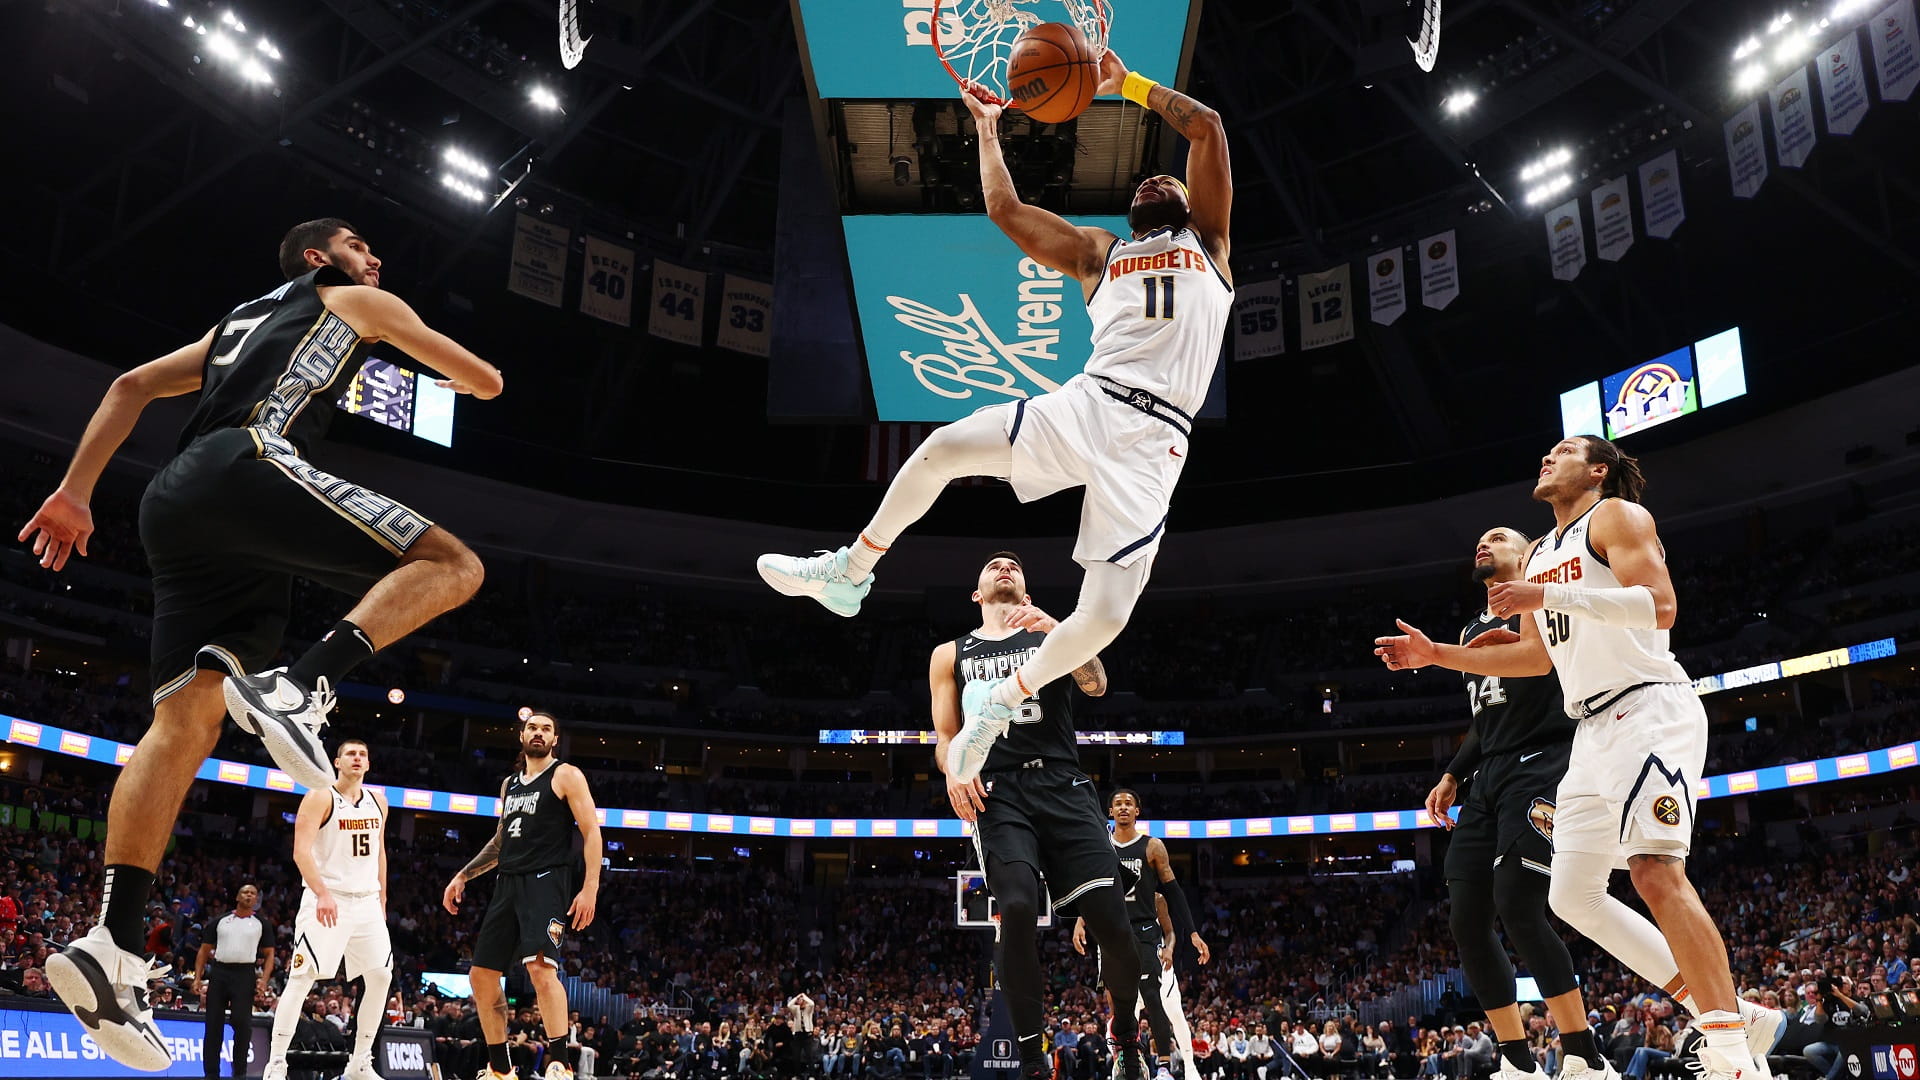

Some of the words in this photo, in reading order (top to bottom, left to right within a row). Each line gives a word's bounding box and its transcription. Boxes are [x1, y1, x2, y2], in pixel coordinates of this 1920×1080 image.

[1109, 247, 1206, 283] NUGGETS
[589, 271, 625, 300] 40
[1143, 275, 1175, 320] 11
[1308, 282, 1342, 299] LEVER
[659, 292, 695, 321] 44
[730, 305, 764, 333] 33
[1312, 296, 1343, 325] 12
[886, 294, 1034, 399] Ball
[1016, 257, 1064, 359] Arena
[1239, 308, 1278, 335] 55
[211, 311, 274, 366] 7
[1544, 609, 1571, 647] 50
[1467, 675, 1508, 719] 24
[504, 791, 541, 819] MEMPHIS
[338, 818, 379, 831] NUGGETS
[508, 817, 522, 838] 4
[352, 833, 370, 857] 15
[0, 1029, 20, 1059] E
[25, 1031, 77, 1060] ALL
[386, 1042, 425, 1071] KICKS
[983, 1060, 992, 1069] GET
[992, 1060, 1001, 1069] THE
[1001, 1060, 1011, 1069] NEW
[1011, 1060, 1021, 1069] APP
[1848, 1054, 1861, 1078] TNT
[1899, 1048, 1915, 1077] TNT
